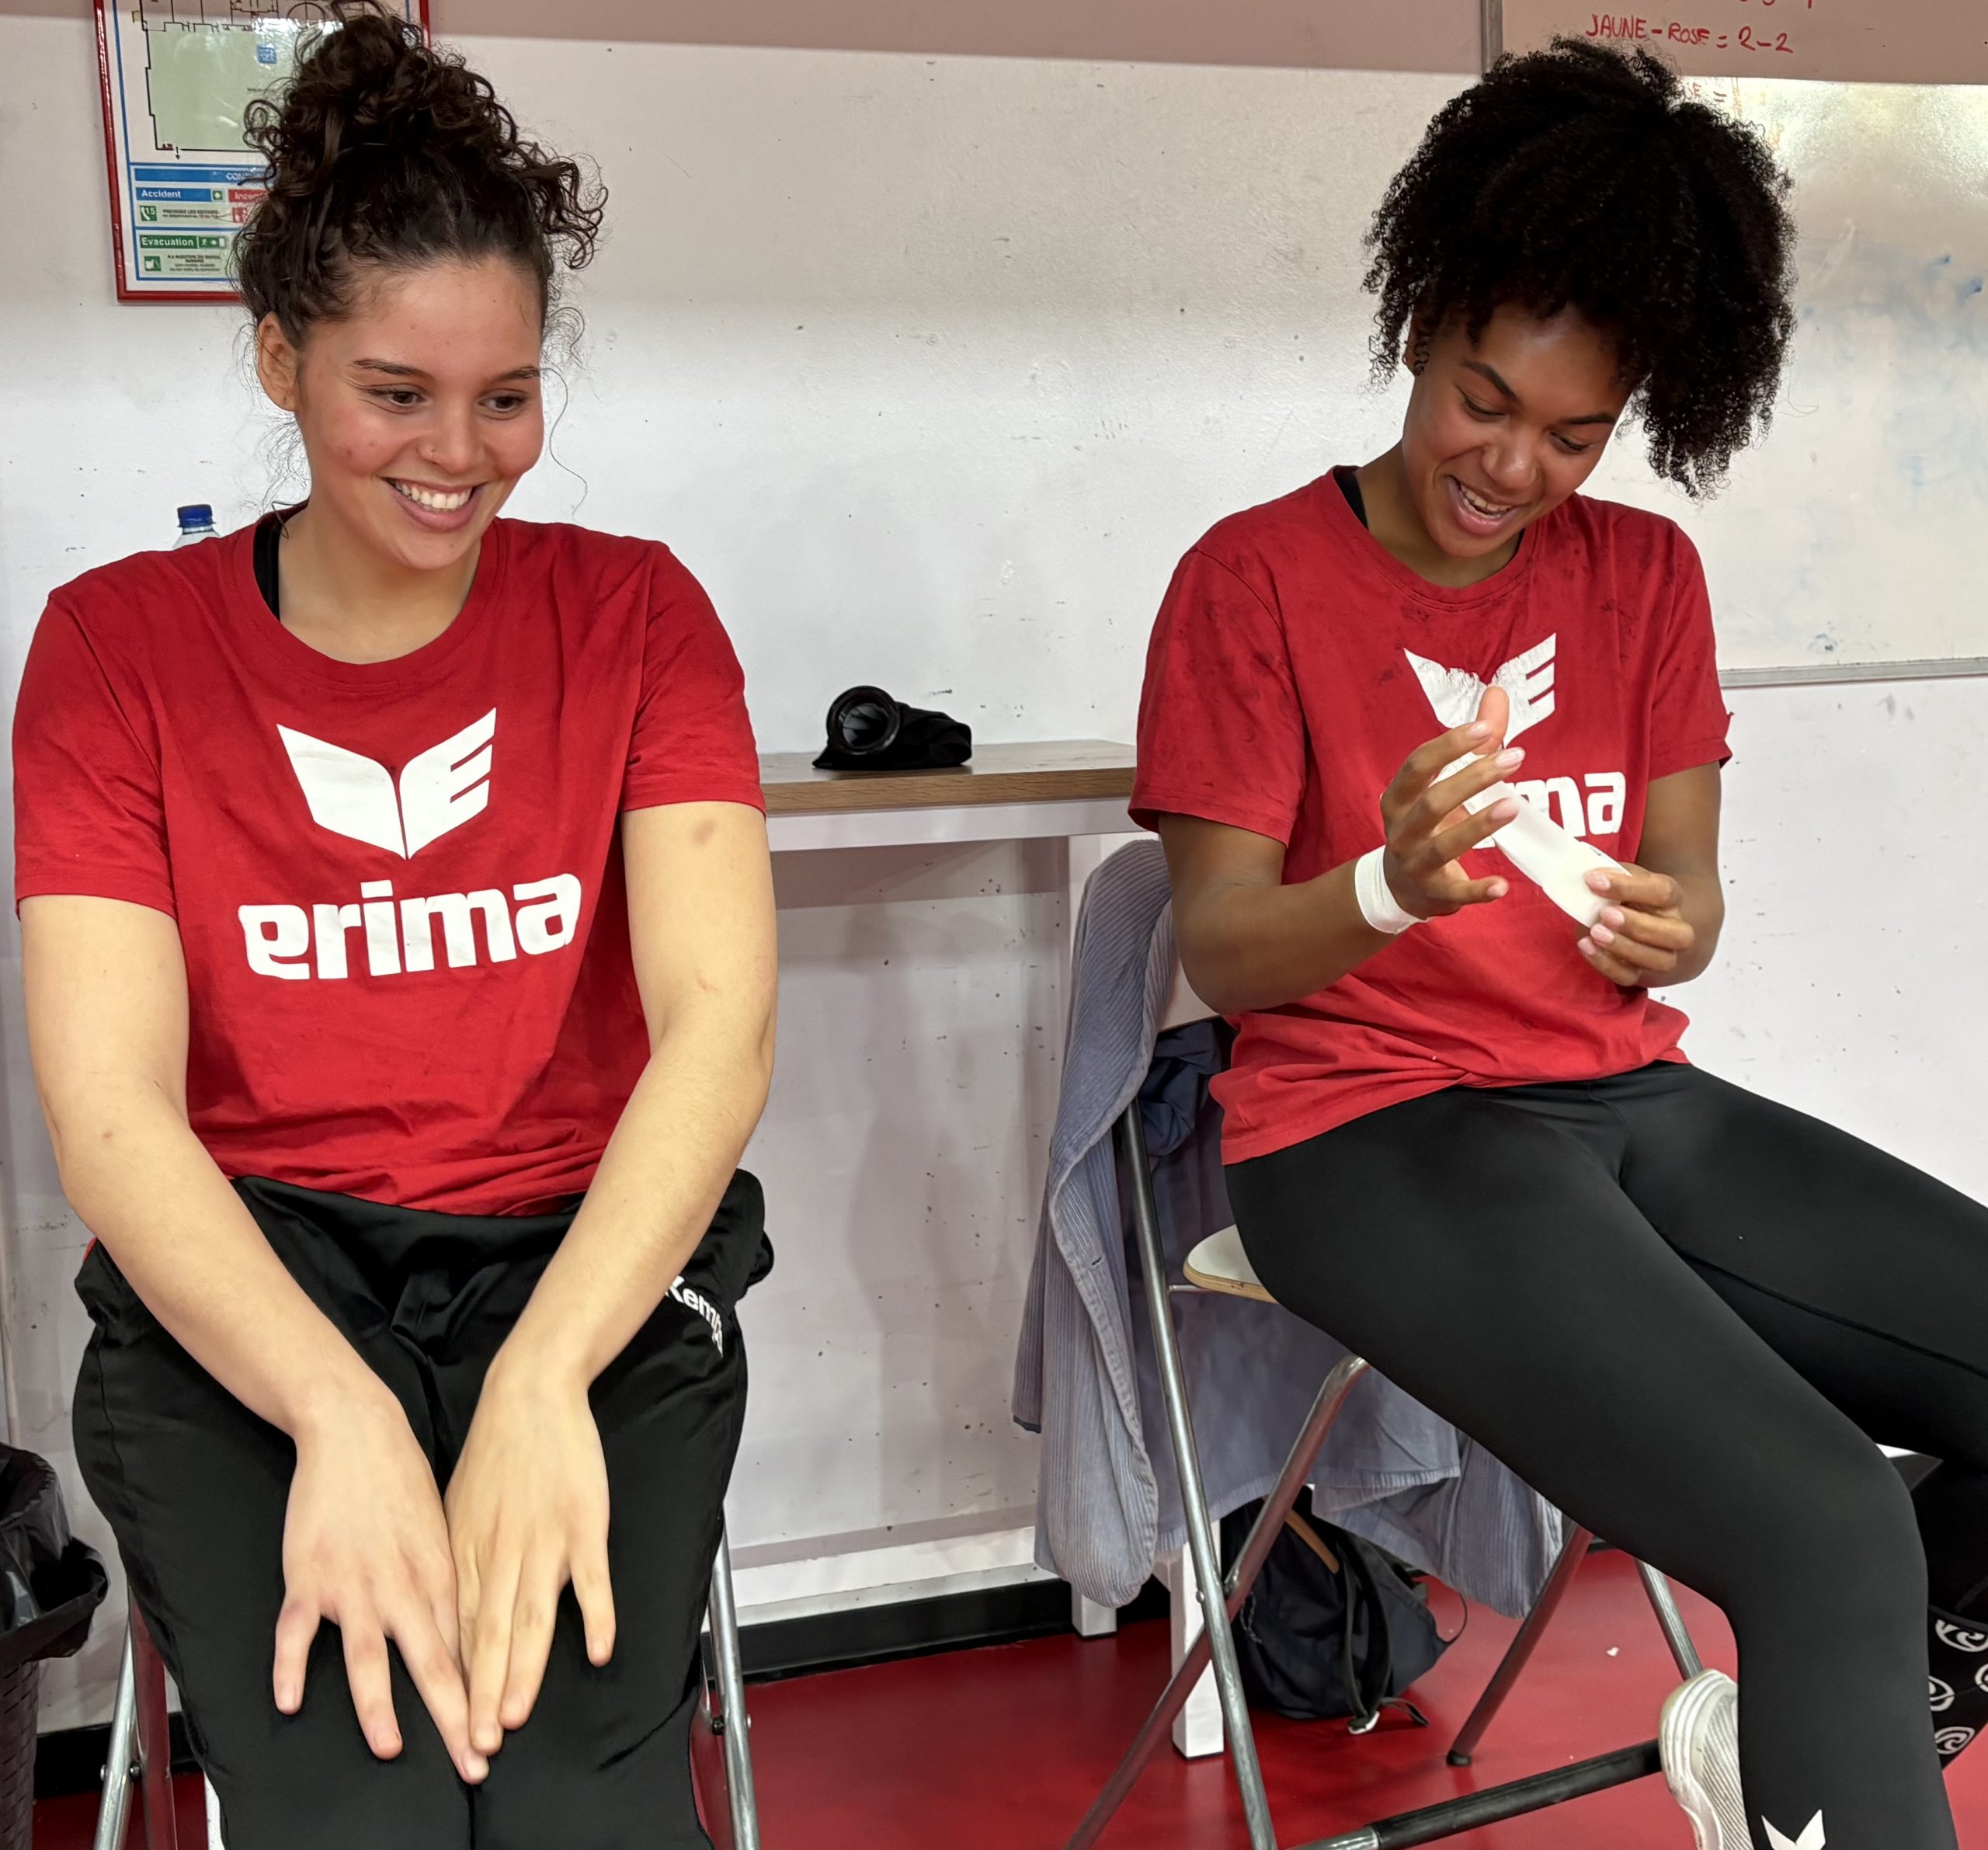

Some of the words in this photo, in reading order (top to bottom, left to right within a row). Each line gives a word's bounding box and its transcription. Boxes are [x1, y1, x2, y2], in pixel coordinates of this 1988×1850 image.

[141, 189, 181, 198] Accident
[141, 237, 193, 246] Evacuation
[238, 873, 582, 980] erima
